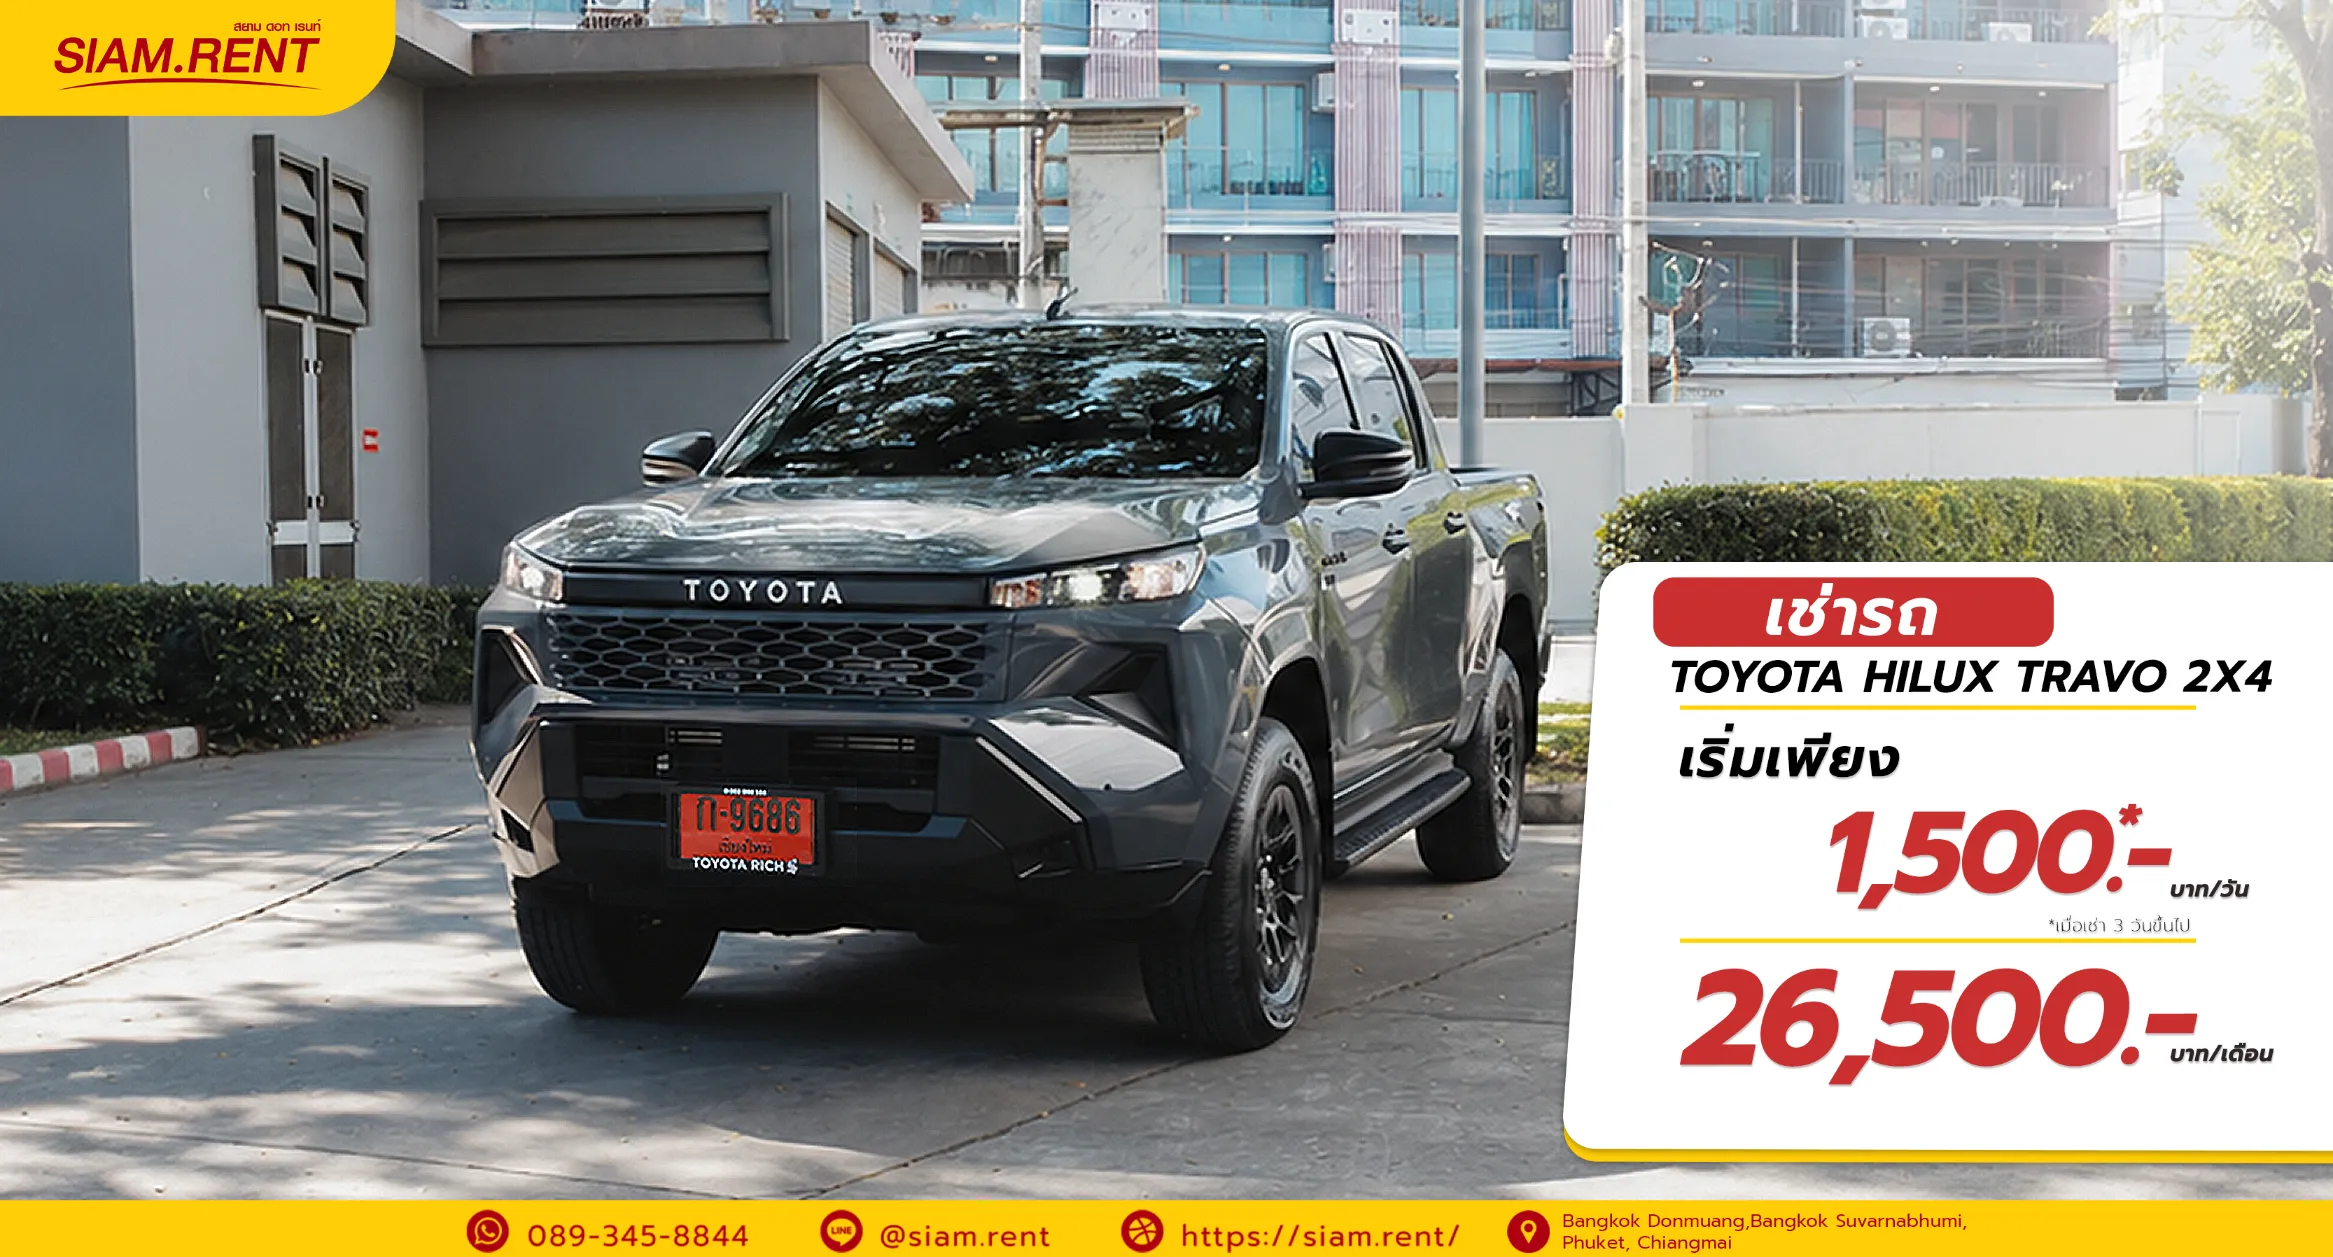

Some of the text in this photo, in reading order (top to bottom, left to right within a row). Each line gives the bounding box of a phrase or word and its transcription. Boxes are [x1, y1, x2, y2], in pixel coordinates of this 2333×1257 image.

[684, 579, 842, 605] TOYOTA
[692, 856, 785, 873] TOYOTA RICH
